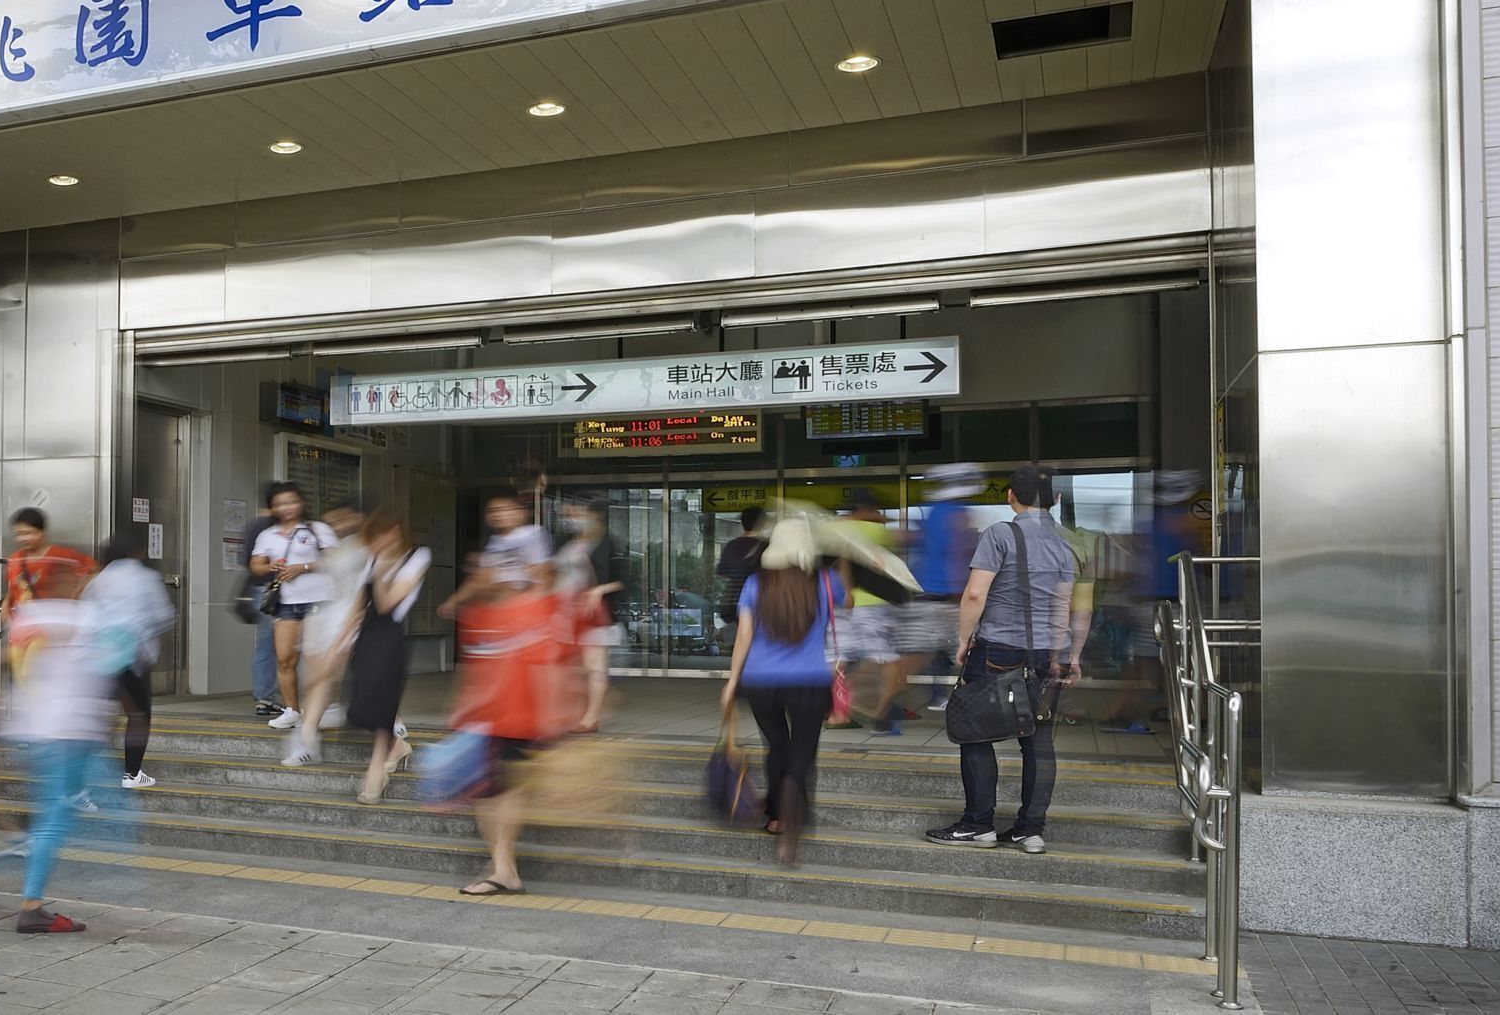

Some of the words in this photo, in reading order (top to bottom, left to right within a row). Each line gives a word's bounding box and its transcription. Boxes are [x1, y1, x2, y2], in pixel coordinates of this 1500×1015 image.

[819, 352, 897, 376] 售票處
[666, 360, 763, 385] 車站大廳
[822, 379, 878, 391] Tickets
[668, 390, 702, 400] Main
[706, 386, 735, 398] Hall
[631, 420, 661, 432] 11:01
[666, 416, 698, 425] Local
[631, 436, 662, 447] 11:06
[666, 432, 698, 441] Local
